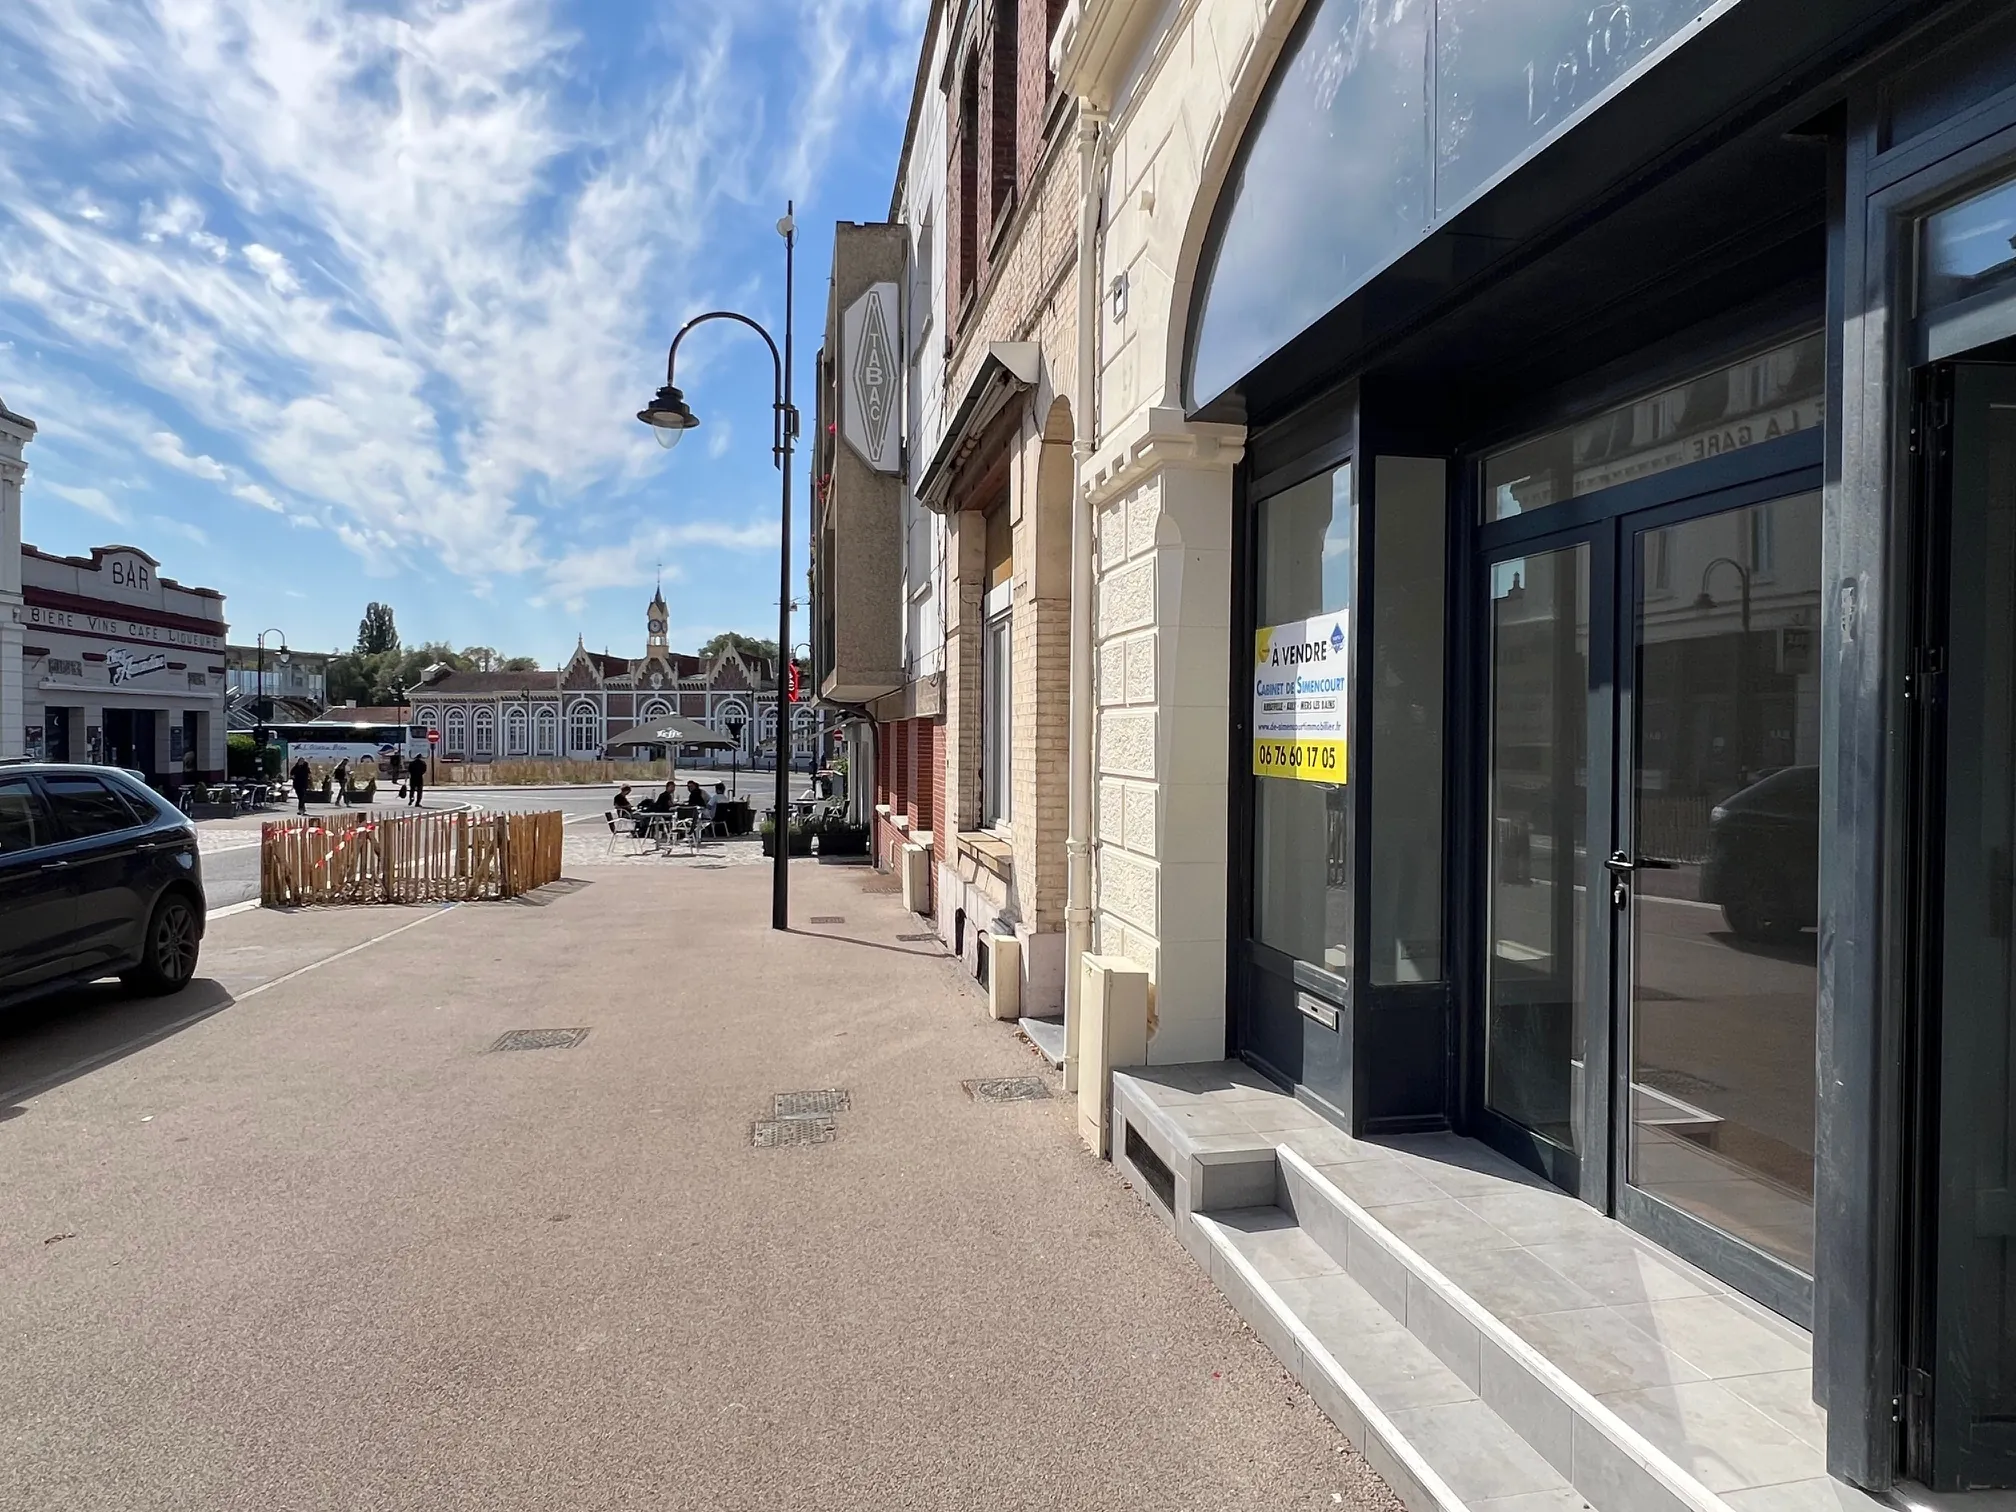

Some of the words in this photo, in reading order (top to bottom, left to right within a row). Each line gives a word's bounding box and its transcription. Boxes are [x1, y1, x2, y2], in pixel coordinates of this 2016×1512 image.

[866, 333, 883, 421] TABAC
[112, 561, 149, 591] BAR
[31, 608, 73, 628] BIERE
[87, 616, 117, 633] VINS
[168, 630, 218, 648] LIQUEURS
[1271, 642, 1280, 667] À
[1282, 640, 1327, 666] VENDRE
[1256, 680, 1284, 696] CABINET
[1286, 681, 1295, 694] DE
[1297, 676, 1345, 694] SIMENCOURT
[1259, 744, 1272, 765] 06
[1275, 745, 1287, 766] 76
[1289, 746, 1303, 767] 60
[1307, 746, 1318, 767] 17
[1321, 747, 1336, 769] 05
